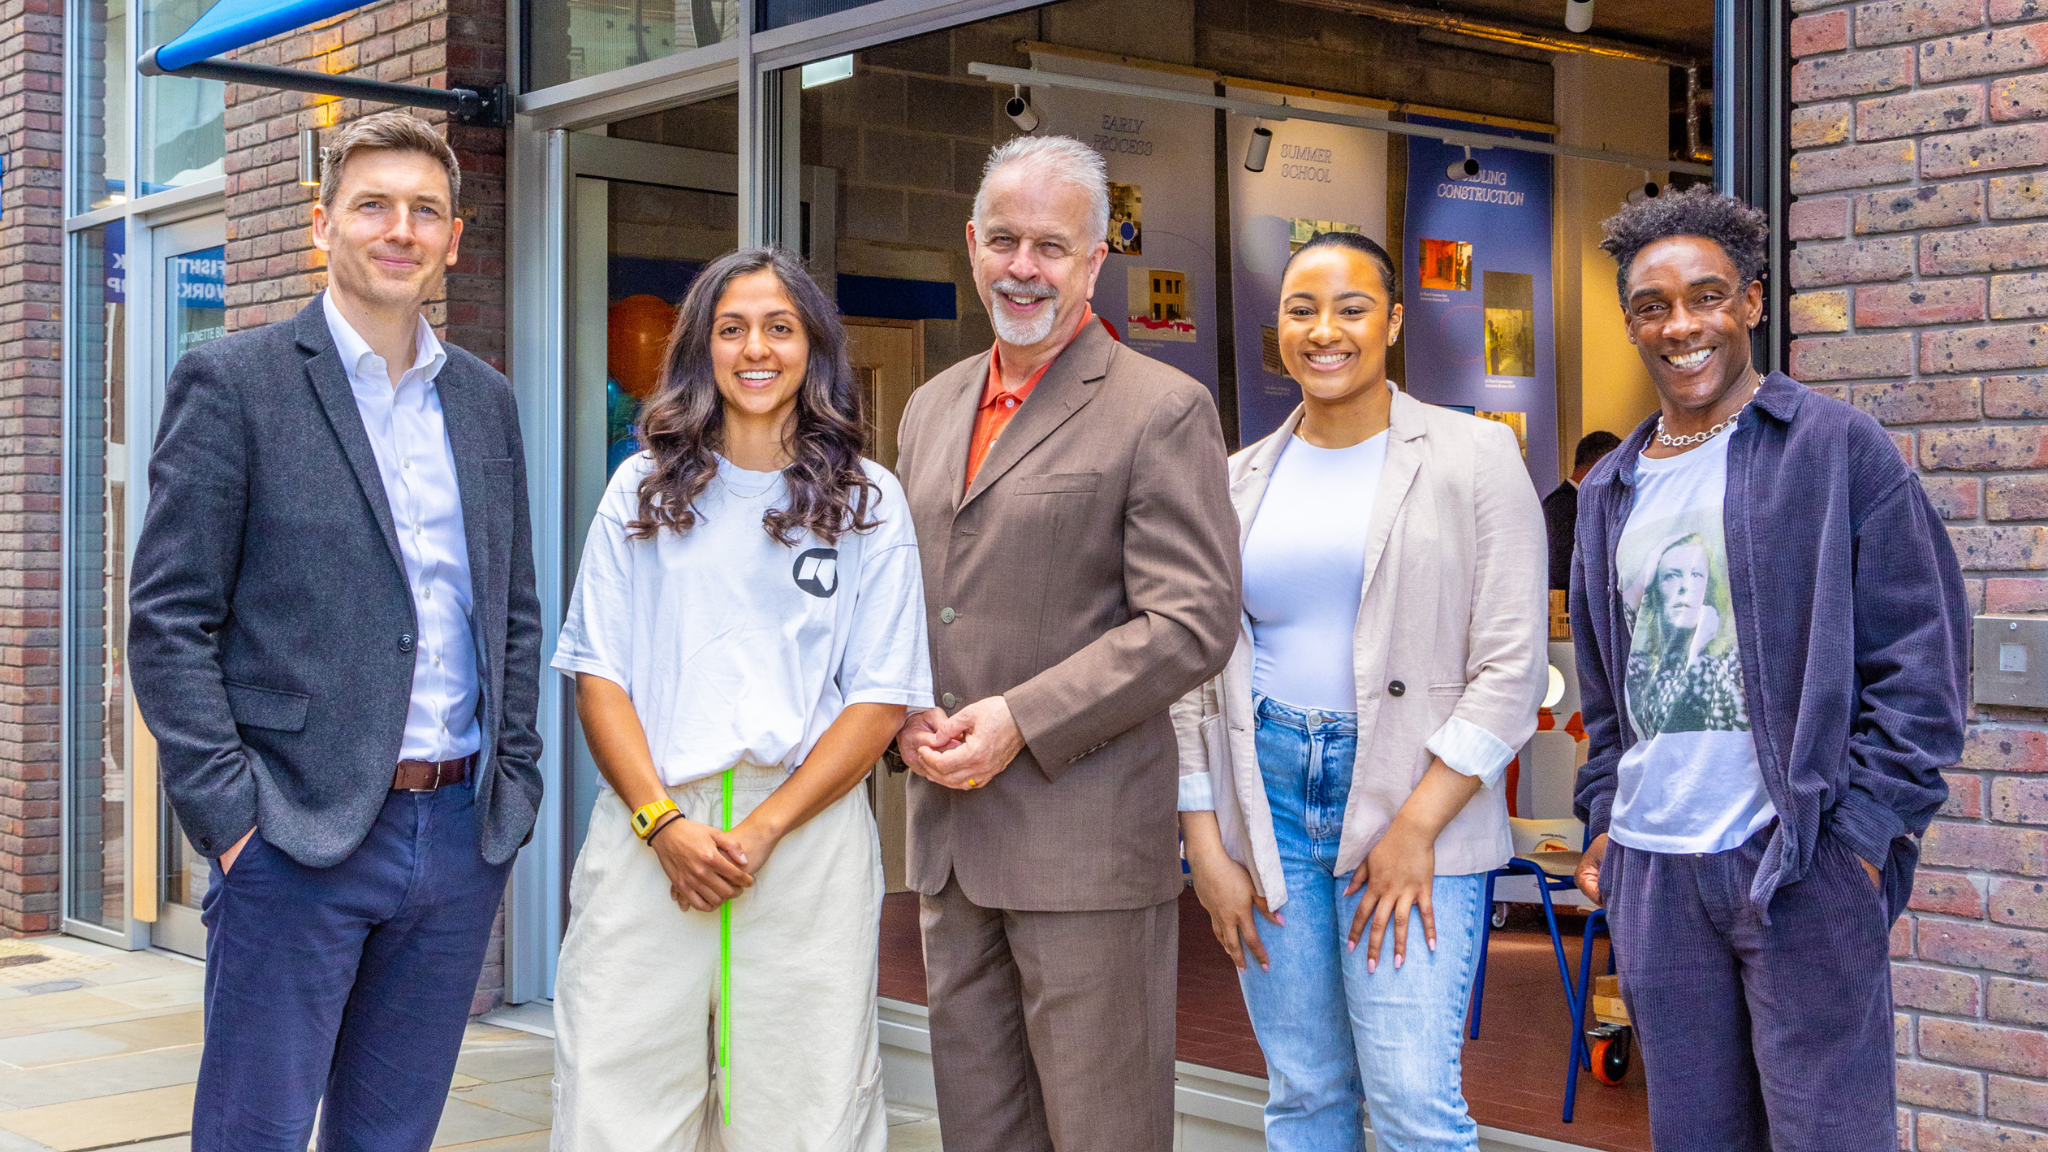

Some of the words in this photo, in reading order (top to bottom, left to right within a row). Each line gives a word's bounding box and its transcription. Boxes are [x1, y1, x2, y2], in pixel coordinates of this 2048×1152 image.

[1102, 114, 1144, 134] EARLY
[1093, 133, 1153, 156] PROCESS
[1280, 143, 1332, 164] SUMMER
[1281, 163, 1332, 183] SCHOOL
[1436, 183, 1525, 206] CONSTRUCTION
